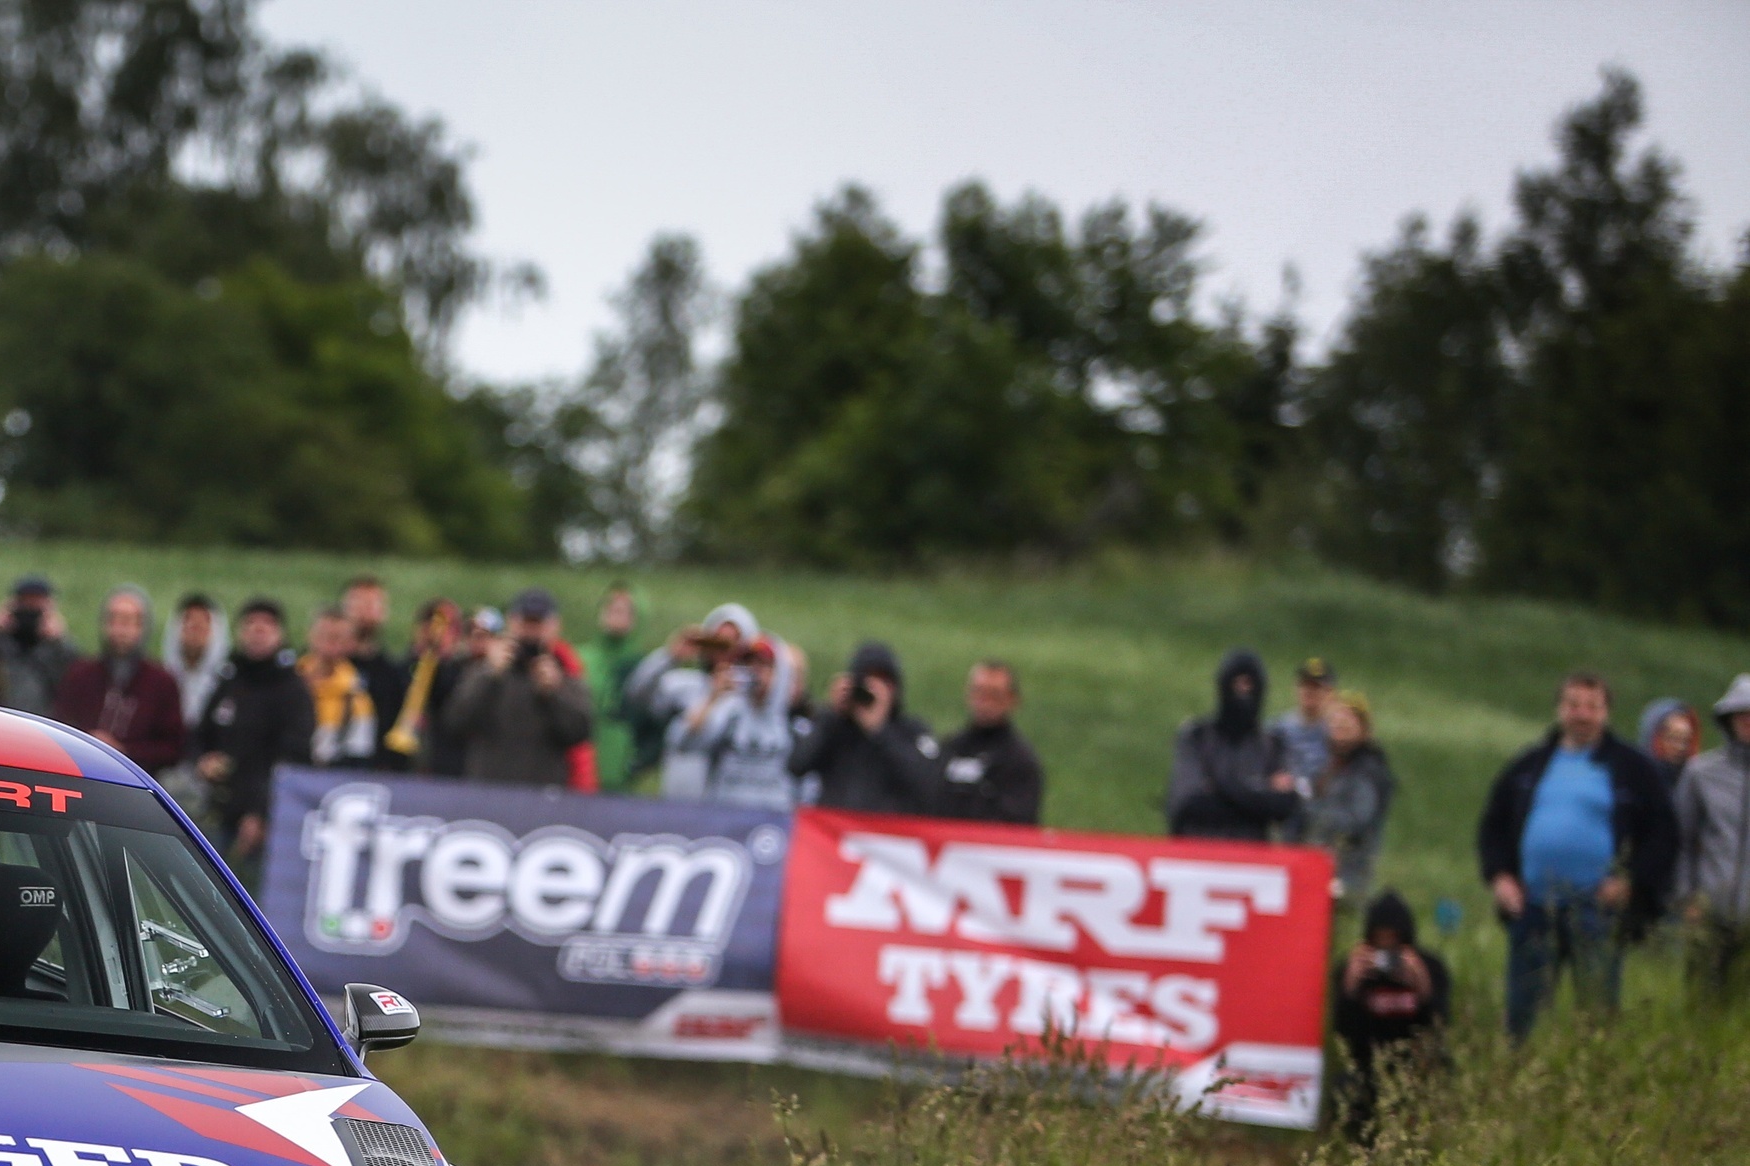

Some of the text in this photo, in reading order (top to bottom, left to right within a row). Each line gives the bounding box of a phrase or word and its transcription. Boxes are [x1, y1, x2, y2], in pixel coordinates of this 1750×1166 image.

[19, 889, 55, 904] OMP
[309, 790, 743, 942] freem
[825, 831, 1289, 964] MRF
[877, 945, 1218, 1051] TYRES
